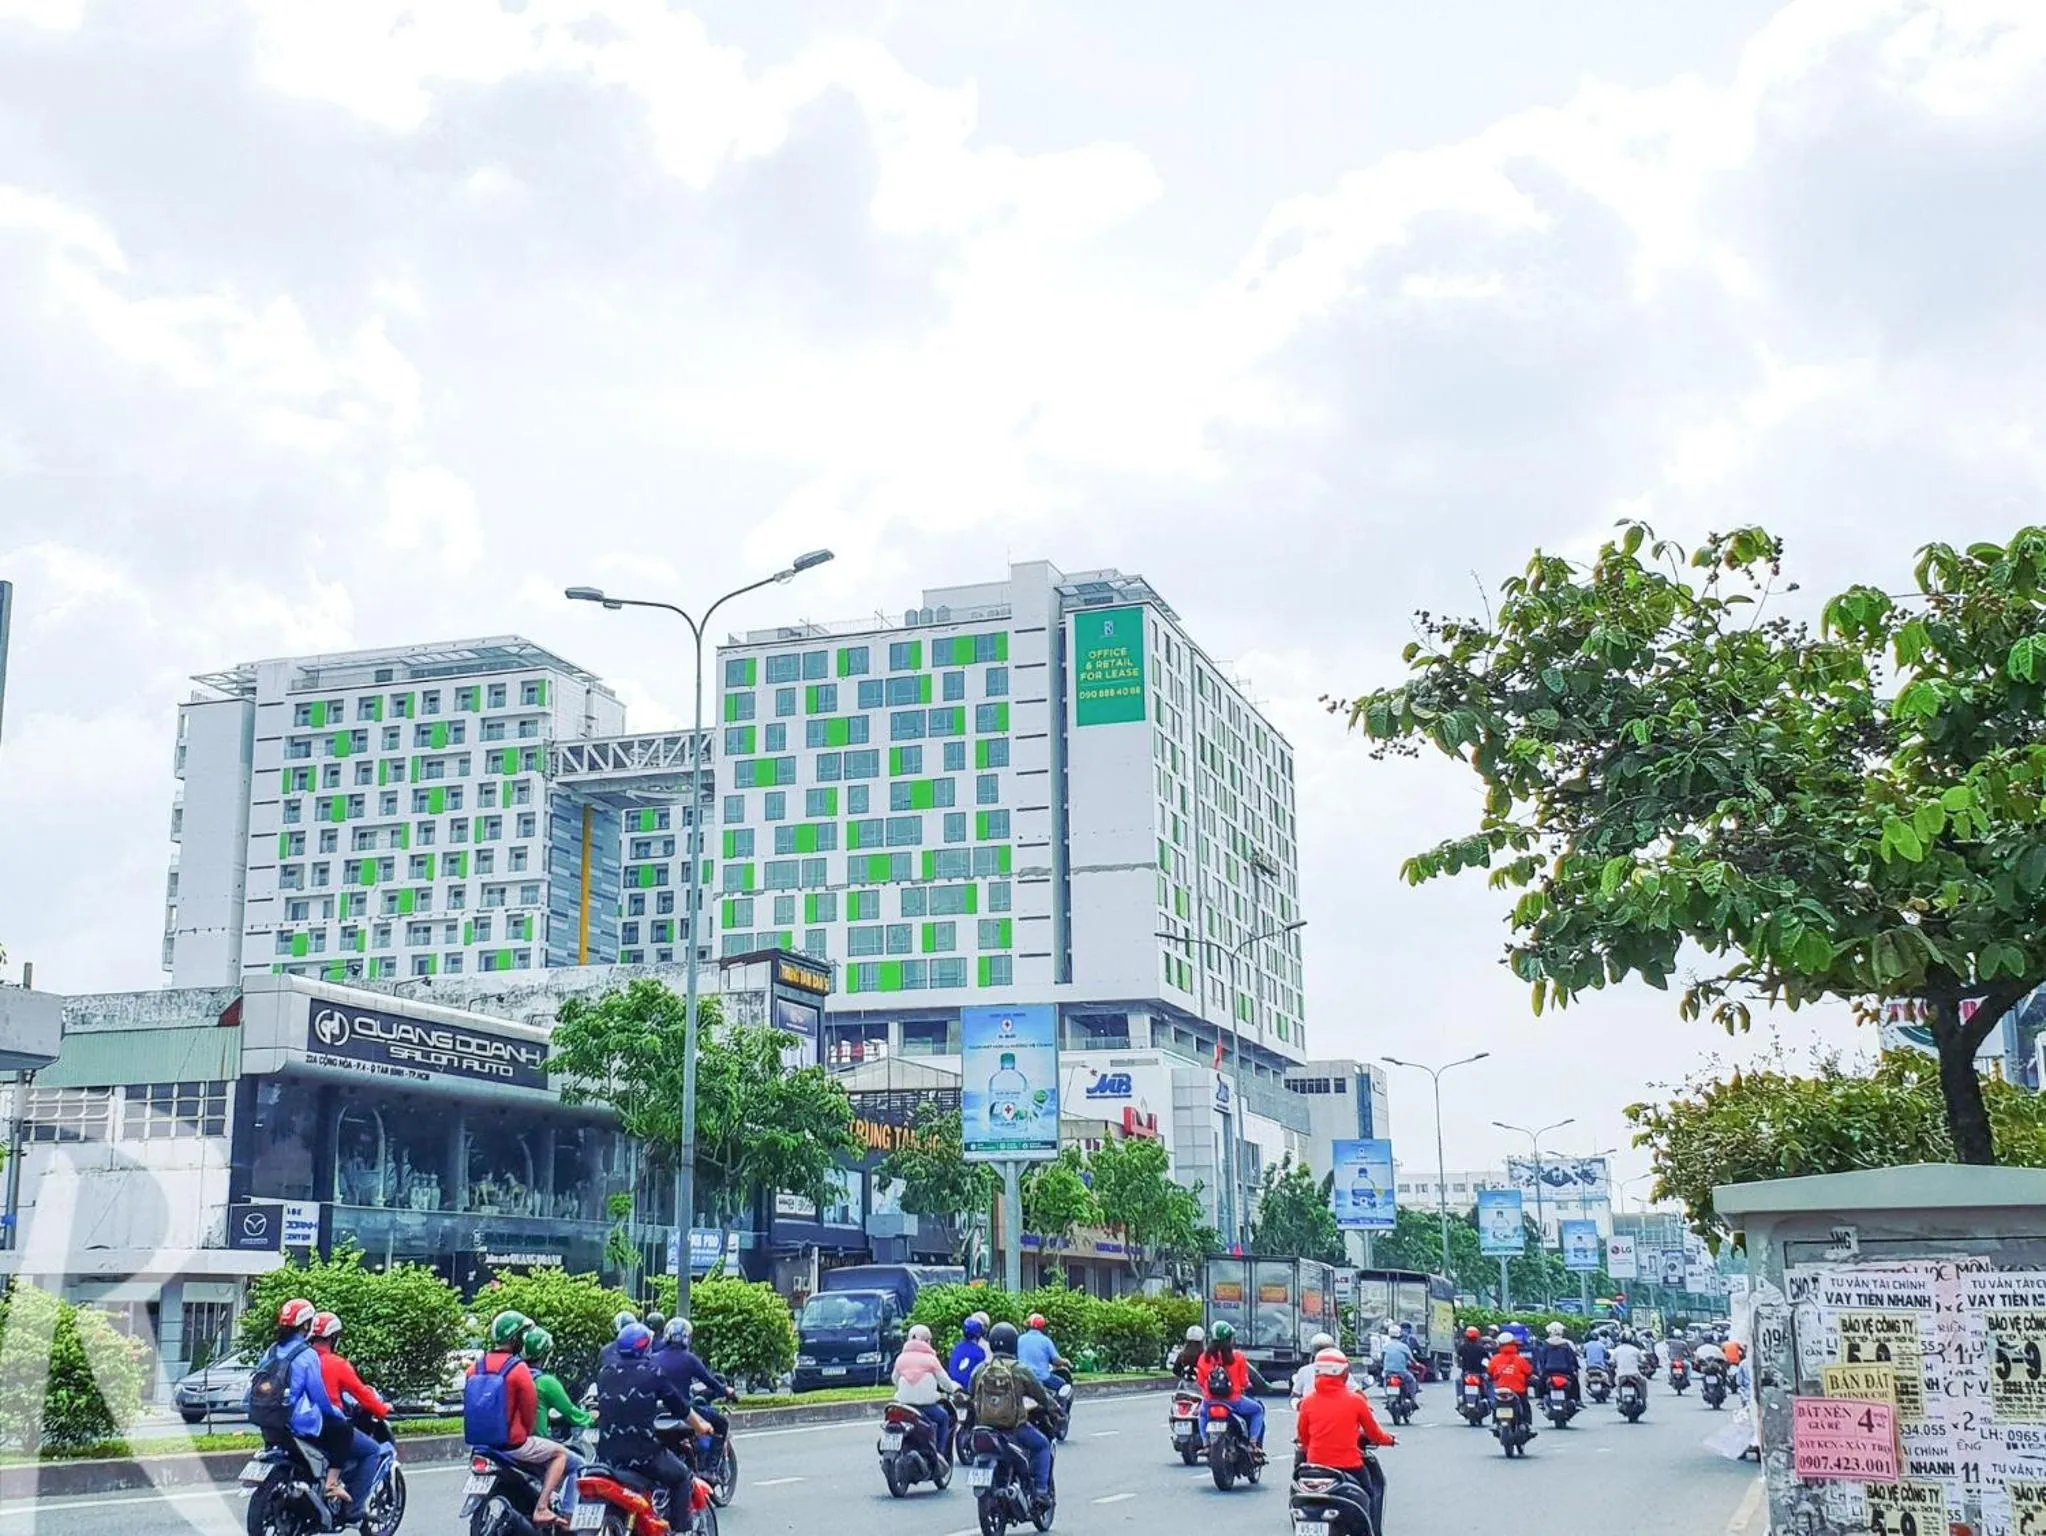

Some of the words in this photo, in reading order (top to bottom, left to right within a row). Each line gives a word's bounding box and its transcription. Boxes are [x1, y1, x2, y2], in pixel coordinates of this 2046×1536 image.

[1088, 648, 1128, 660] OFFICE
[1096, 658, 1133, 669] RETAIL
[1080, 671, 1102, 680] FOR
[1106, 667, 1139, 679] LEASE
[390, 1046, 458, 1068] SALON
[462, 1058, 513, 1076] AUTO
[850, 1119, 891, 1152] TRUNG
[1621, 1246, 1632, 1254] LG
[1892, 1278, 1926, 1290] CHÍNH
[1825, 1292, 1854, 1305] VAY
[1887, 1294, 1932, 1308] NHANH
[1968, 1294, 1995, 1307] VAY
[1902, 1319, 1914, 1334] TY
[1830, 1370, 1860, 1390] BÁN
[1858, 1408, 1876, 1433] 4
[1980, 1428, 2003, 1440] LH:
[2008, 1430, 2040, 1442] 0965
[1800, 1456, 1891, 1474] 0907.423.001
[1910, 1461, 1955, 1474] NHANH
[1929, 1488, 1940, 1504] TY
